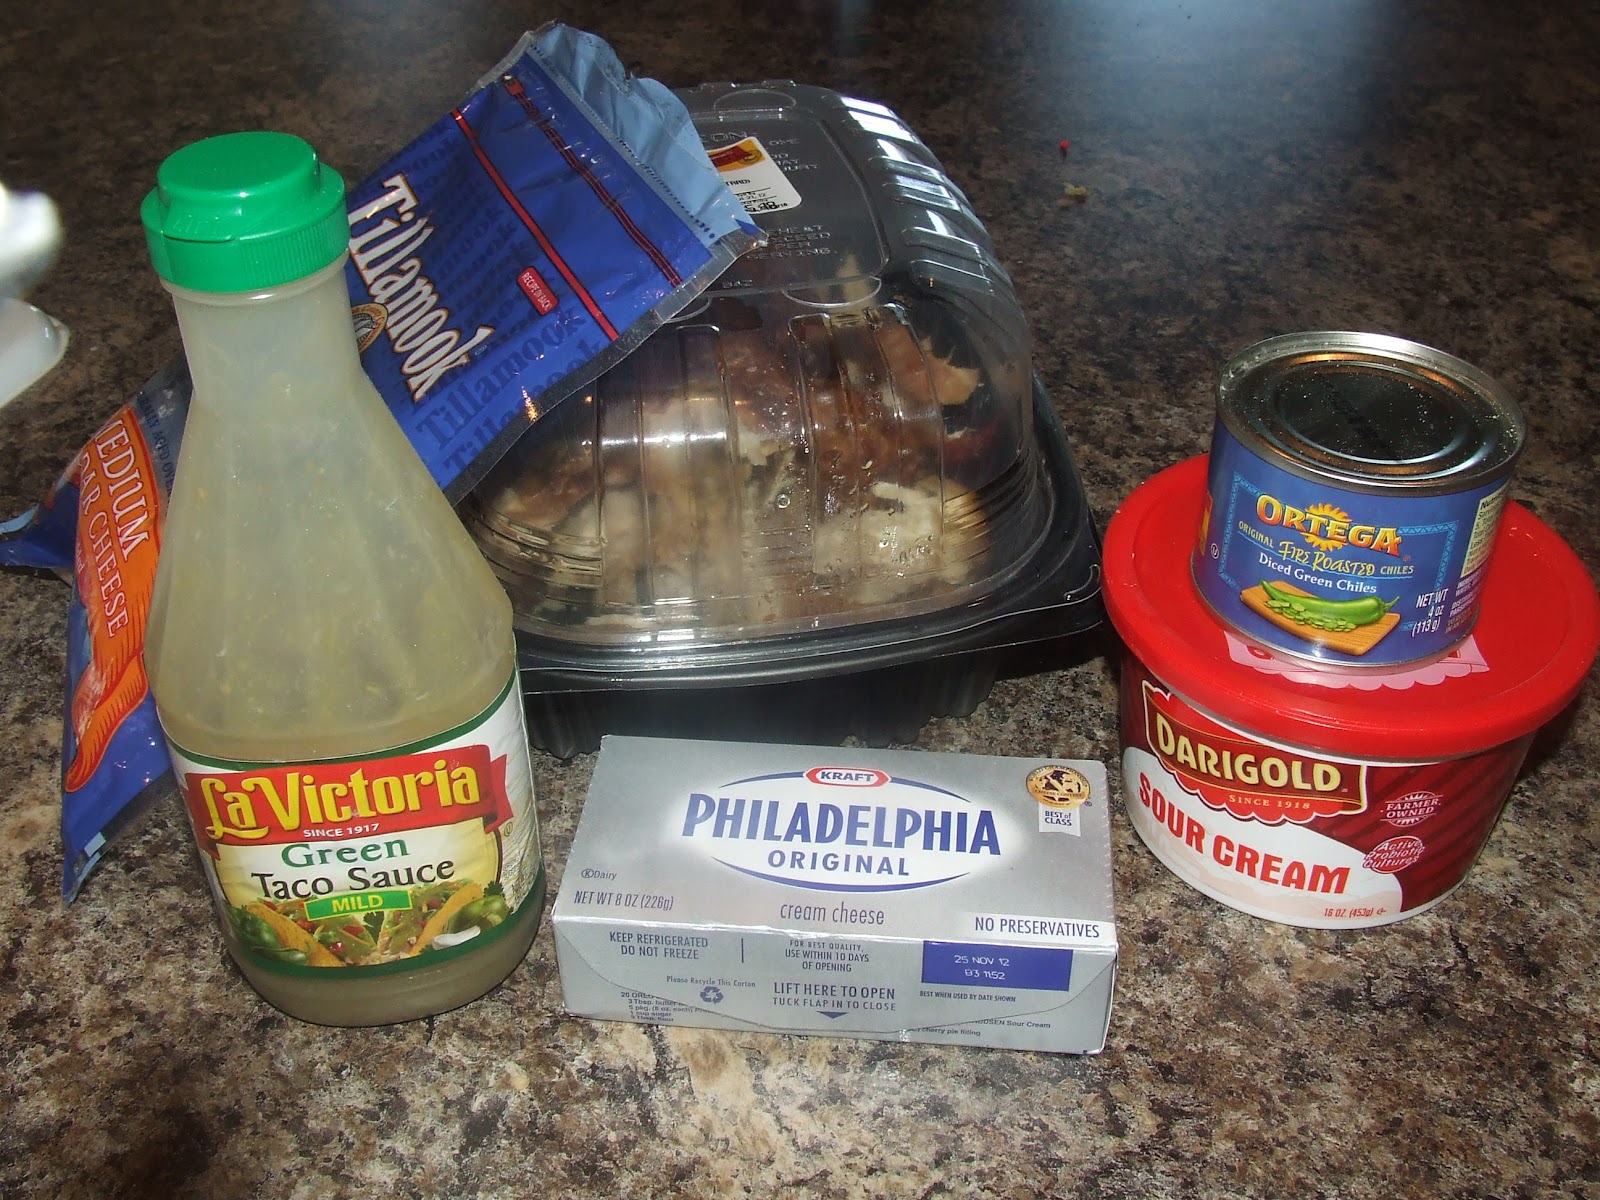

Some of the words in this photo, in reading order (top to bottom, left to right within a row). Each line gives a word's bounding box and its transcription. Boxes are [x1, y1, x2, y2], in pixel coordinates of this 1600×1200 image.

[348, 172, 495, 402] Tillamook
[520, 272, 540, 294] RECIPE
[416, 307, 586, 452] Tillamook
[1257, 494, 1402, 556] ORTEGA
[1238, 521, 1274, 548] ORIGINAL
[1380, 565, 1414, 575] CHILES
[88, 510, 130, 638] CHEESE
[1259, 552, 1292, 576] Diced
[1294, 569, 1333, 588] Green
[1336, 579, 1377, 594] Chiles
[1416, 592, 1435, 608] NET
[1435, 588, 1449, 604] WT
[1428, 605, 1434, 618] 4
[1156, 713, 1342, 792] DARIGOLD
[820, 771, 875, 783] KRAFT
[200, 777, 270, 840] La
[241, 759, 480, 832] Victoria
[1229, 794, 1270, 808] SINCE
[1277, 799, 1310, 810] 1918
[1386, 797, 1439, 811] FARMER
[1045, 811, 1063, 819] BEST
[1386, 806, 1435, 819] OWNED
[682, 793, 1001, 856] PHILADELPHIA
[1044, 817, 1072, 827] CLASS
[303, 827, 344, 838] SINCE
[346, 823, 380, 836] 1917
[1139, 772, 1205, 854] SOUR
[1213, 834, 1350, 894] CREAM
[281, 838, 409, 868] Green
[1364, 846, 1425, 861] Probiotic
[1378, 840, 1420, 852] Active
[767, 849, 910, 876] ORIGINAL
[1362, 855, 1420, 869] Cultures
[251, 871, 334, 900] Taco
[348, 859, 455, 891] Sauce
[331, 894, 384, 913] MILD
[574, 890, 595, 905] NET
[596, 892, 614, 905] WT
[615, 893, 622, 906] 8
[625, 894, 638, 907] OZ
[780, 903, 826, 923] cream
[832, 903, 885, 925] cheese
[1324, 908, 1334, 917] 16
[975, 916, 995, 932] NO
[1000, 918, 1100, 938] PRESERVATIVES
[610, 930, 633, 943] KEEP
[636, 932, 709, 948] REFRIGERATED
[789, 939, 805, 948] FOR
[808, 941, 827, 950] BEST
[621, 944, 636, 956] DO
[638, 946, 659, 957] NOT
[664, 947, 699, 960] FREEZE
[785, 949, 801, 959] USE
[802, 950, 833, 961] WITHIN
[835, 951, 847, 962] 10
[848, 952, 870, 963] DAYS
[802, 960, 813, 971] OF
[815, 961, 852, 973] OPENING
[954, 955, 968, 965] 25
[972, 956, 994, 966] NOV
[998, 957, 1010, 968] 12
[666, 975, 688, 986] Please
[690, 976, 716, 988] Recycle
[717, 978, 732, 987] This
[733, 979, 756, 989] Carton
[774, 982, 801, 995] LIFT
[803, 983, 837, 997] HERE
[841, 985, 857, 998] TO
[860, 986, 896, 1000] OPEN
[919, 990, 935, 998] BEST
[936, 991, 953, 999] WHEN
[953, 992, 968, 1000] USED
[978, 993, 993, 1001] DATE
[994, 994, 1016, 1003] SHOWN
[773, 997, 800, 1008] TUCK
[802, 998, 829, 1009] FLAP
[831, 999, 844, 1010] IN
[845, 1000, 859, 1010] TO
[863, 1001, 896, 1012] CLOSE
[1006, 1020, 1025, 1028] Sour
[1027, 1021, 1051, 1029] Cream
